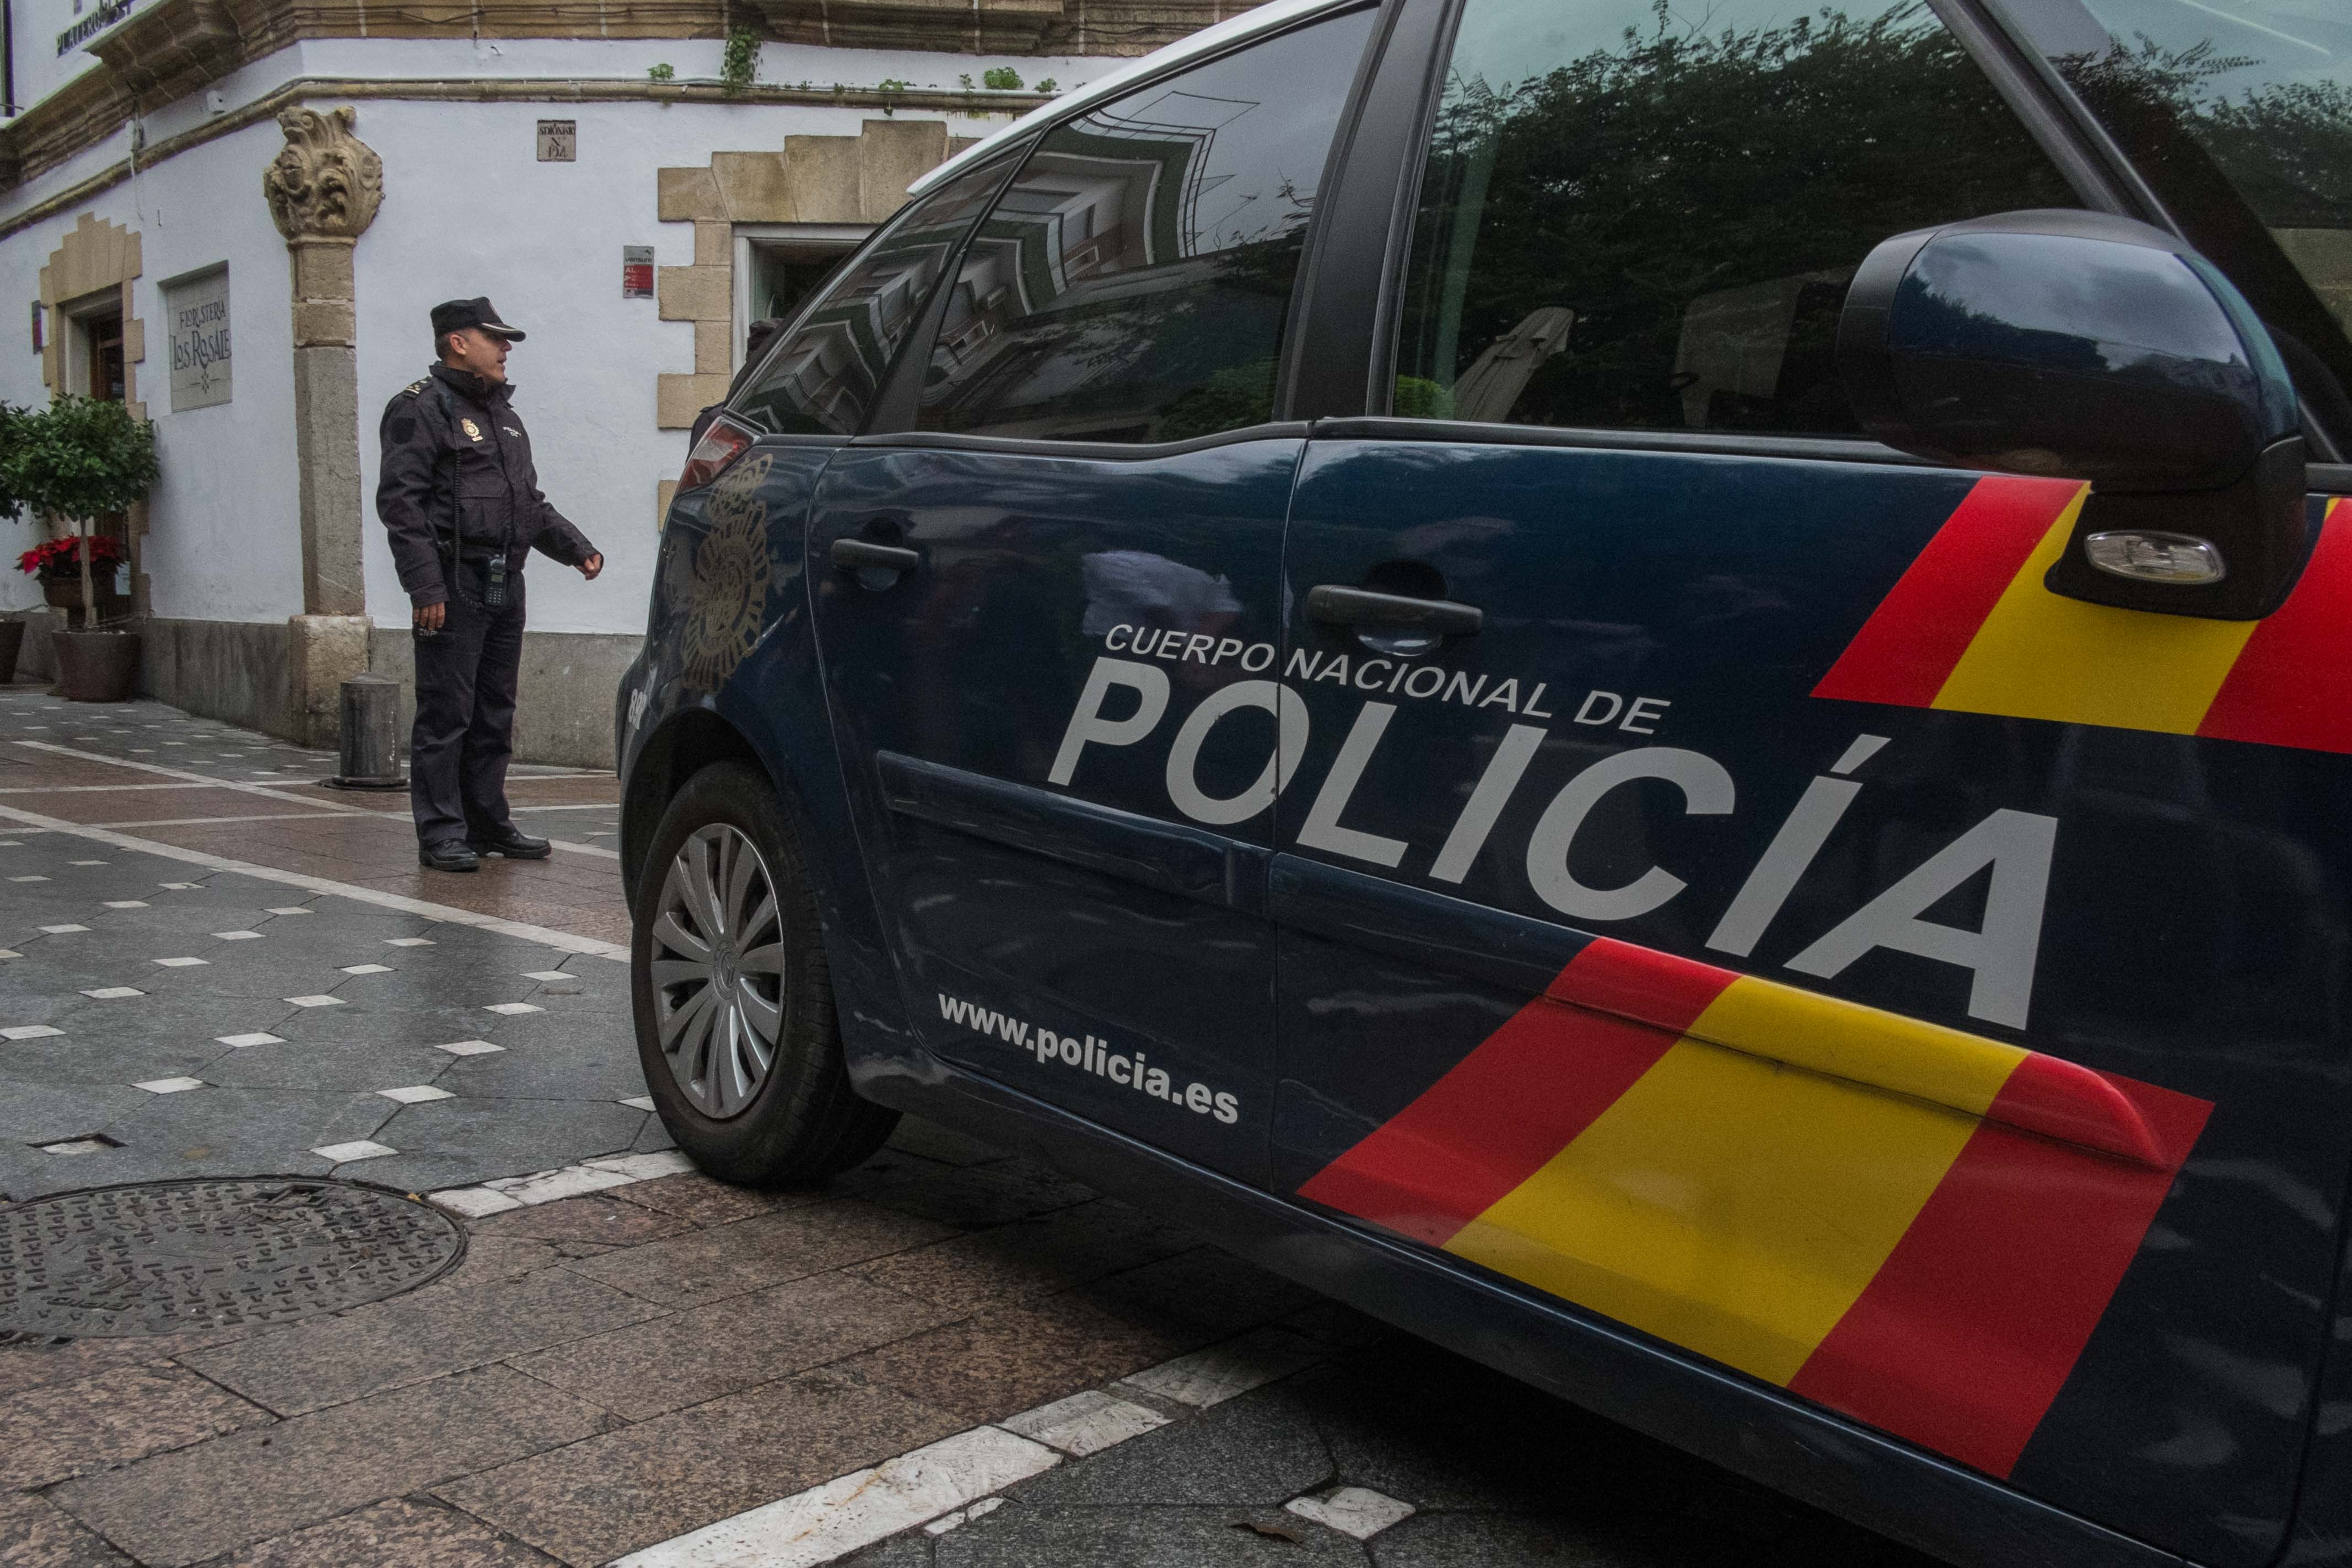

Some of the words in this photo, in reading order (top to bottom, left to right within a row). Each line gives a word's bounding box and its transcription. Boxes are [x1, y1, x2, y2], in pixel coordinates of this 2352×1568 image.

[170, 334, 190, 370] LOS
[191, 326, 232, 369] ROSALE
[1105, 624, 1275, 672] CUERPO
[1284, 648, 1553, 718] NACIONAL
[1574, 689, 1671, 735] DE
[1046, 656, 2059, 1031] POLICÍA
[939, 993, 1239, 1124] www.policia.es
